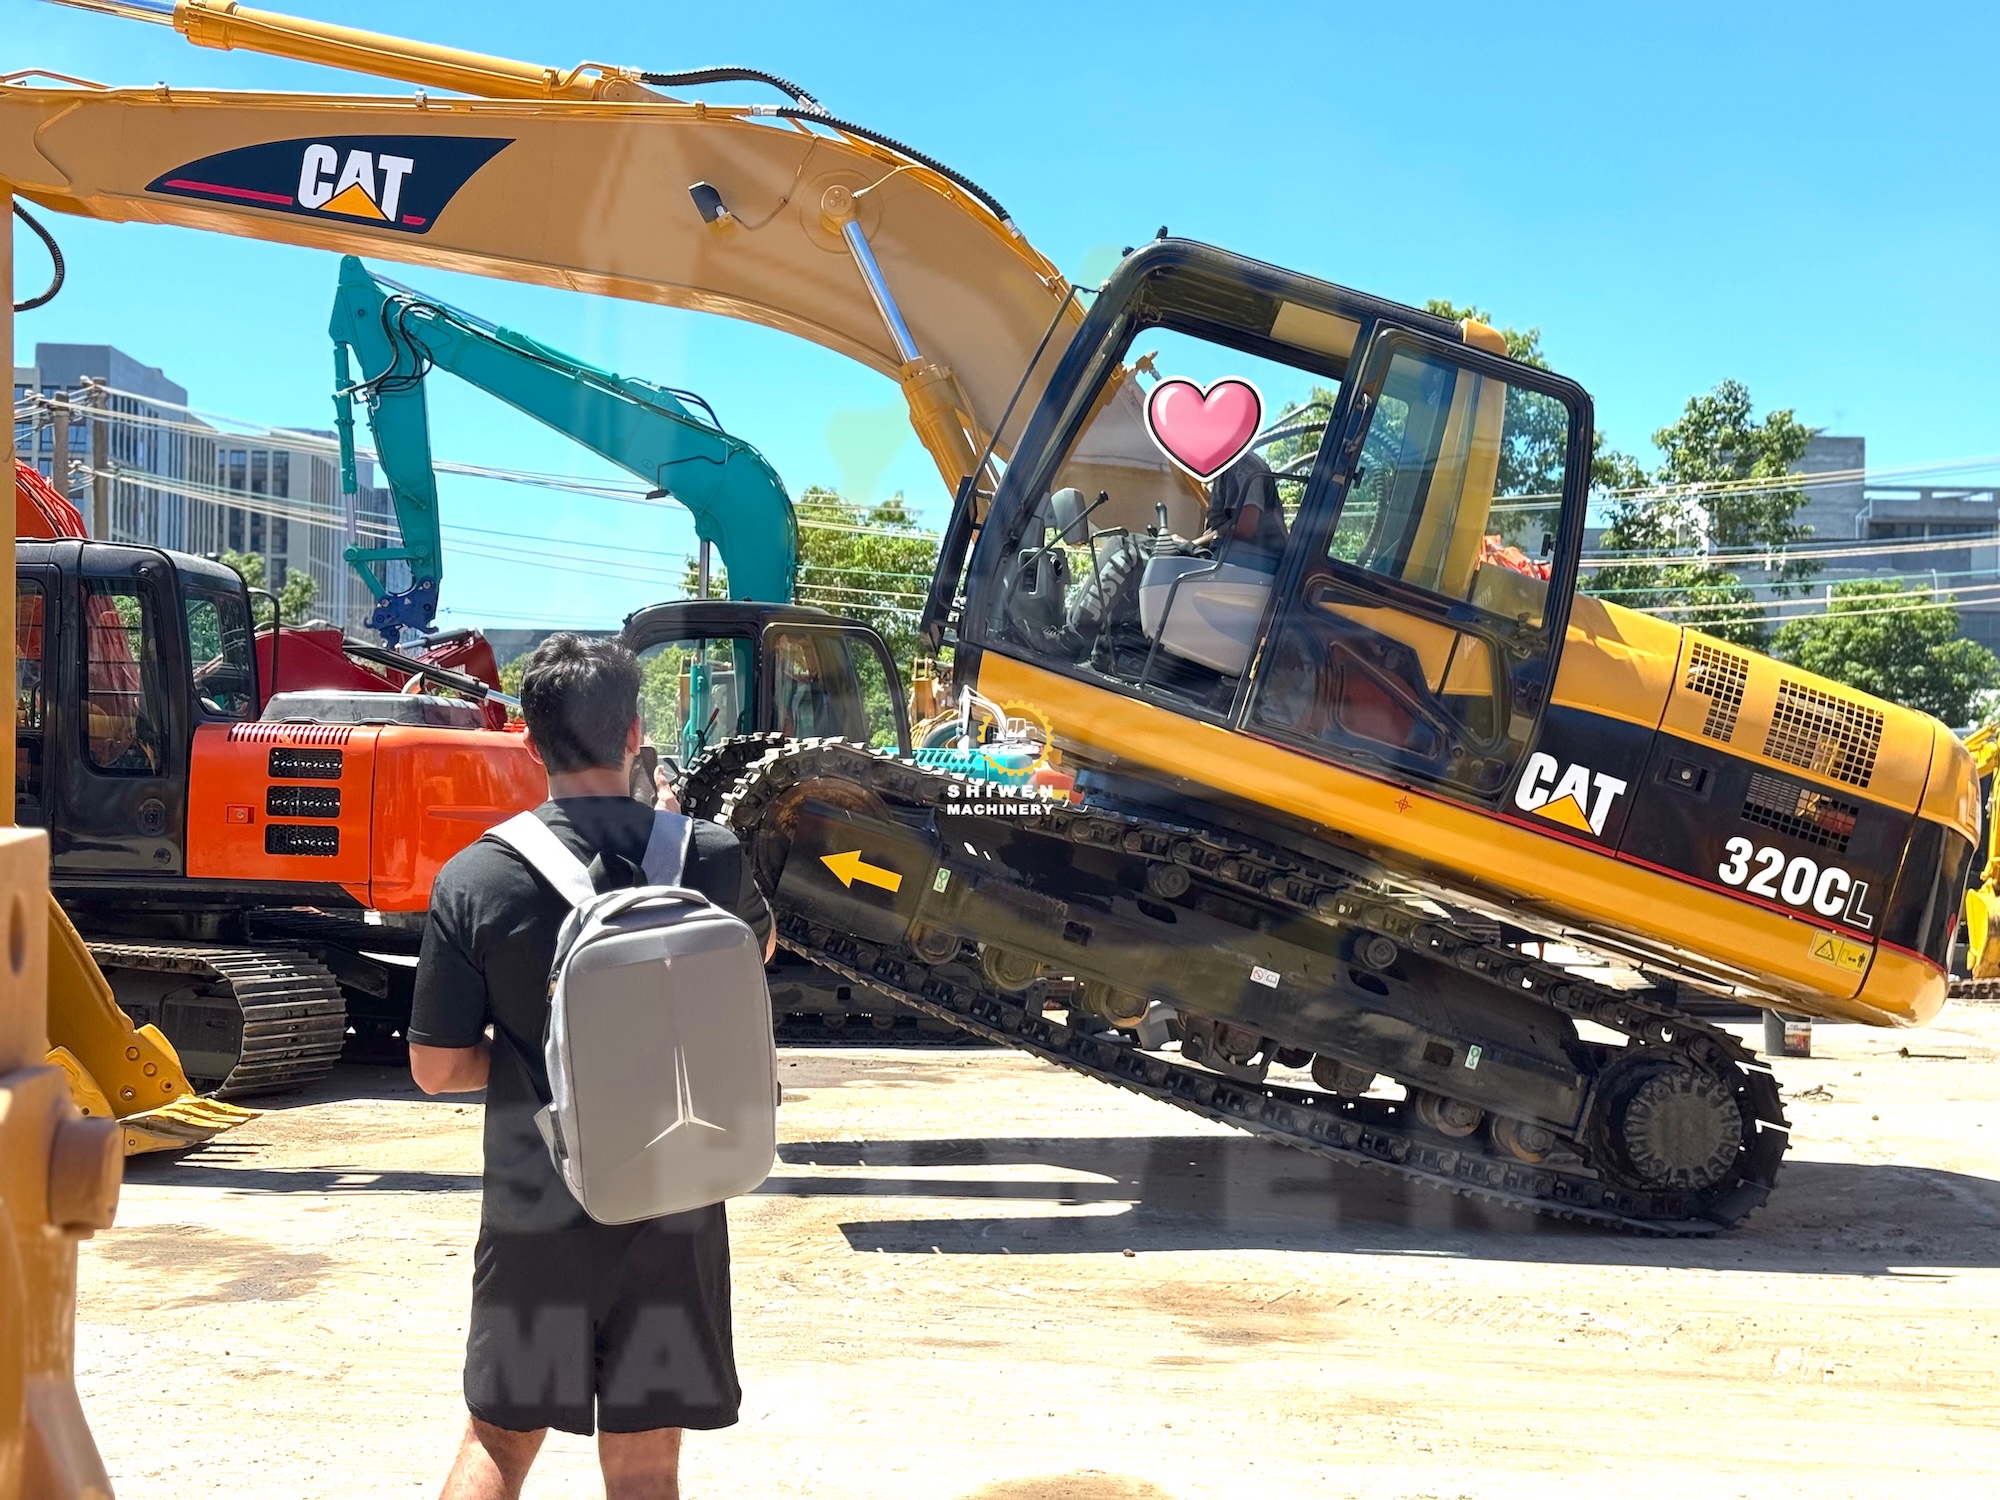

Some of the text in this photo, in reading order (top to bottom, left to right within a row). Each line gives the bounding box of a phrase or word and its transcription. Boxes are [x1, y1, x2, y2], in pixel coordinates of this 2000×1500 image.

[297, 143, 415, 222] CAT
[1079, 561, 1126, 622] JUST
[1514, 751, 1628, 837] CAT
[1718, 836, 1874, 930] 320CL
